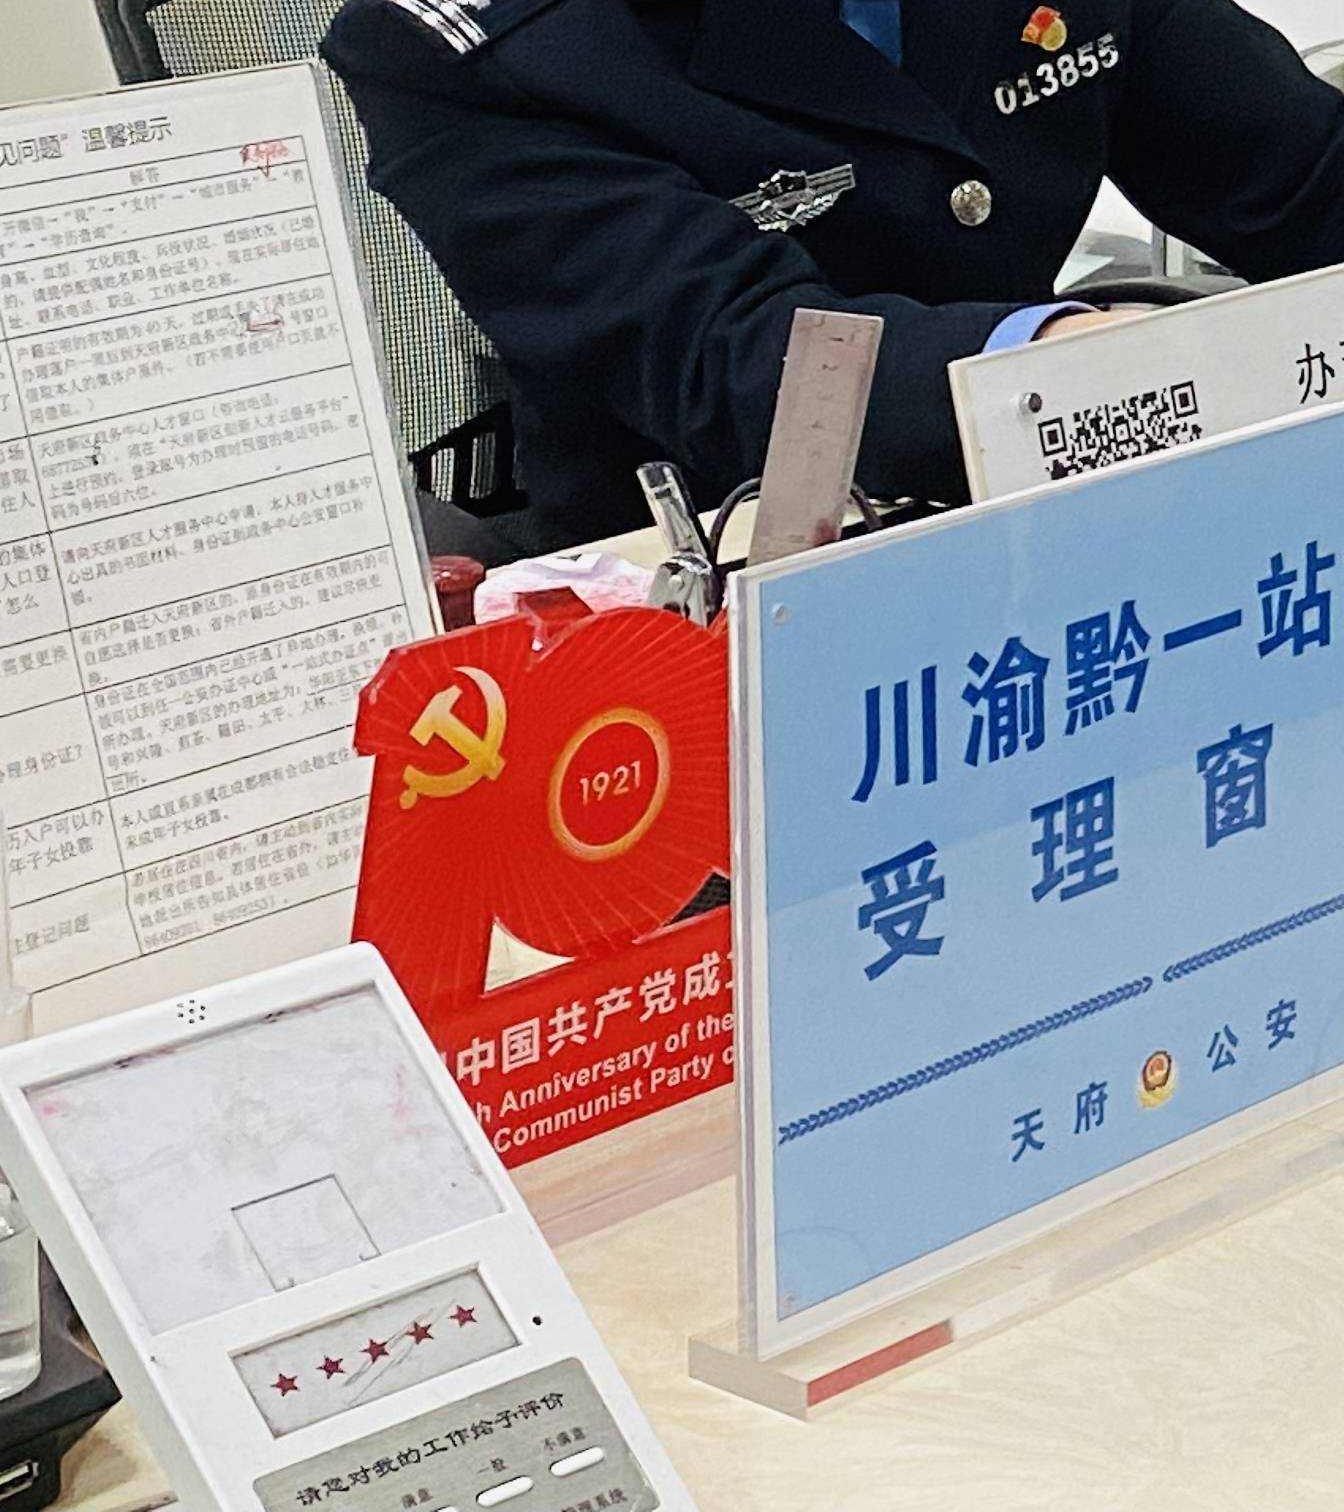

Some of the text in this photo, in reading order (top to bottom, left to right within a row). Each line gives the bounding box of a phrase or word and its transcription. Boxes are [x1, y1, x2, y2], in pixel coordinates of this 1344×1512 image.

[994, 33, 1119, 114] 013855
[82, 116, 173, 152] 温馨提示
[579, 760, 641, 806] 1921
[440, 951, 735, 1086] 中国共产党成
[499, 1041, 657, 1118] Anniversary
[664, 1022, 691, 1053] of
[696, 1012, 735, 1042] the
[493, 1078, 642, 1154] Communist
[650, 1051, 714, 1094] Party
[1011, 999, 1298, 1162] 天府 公安
[295, 1392, 565, 1506] 请您对我的工作给予评价
